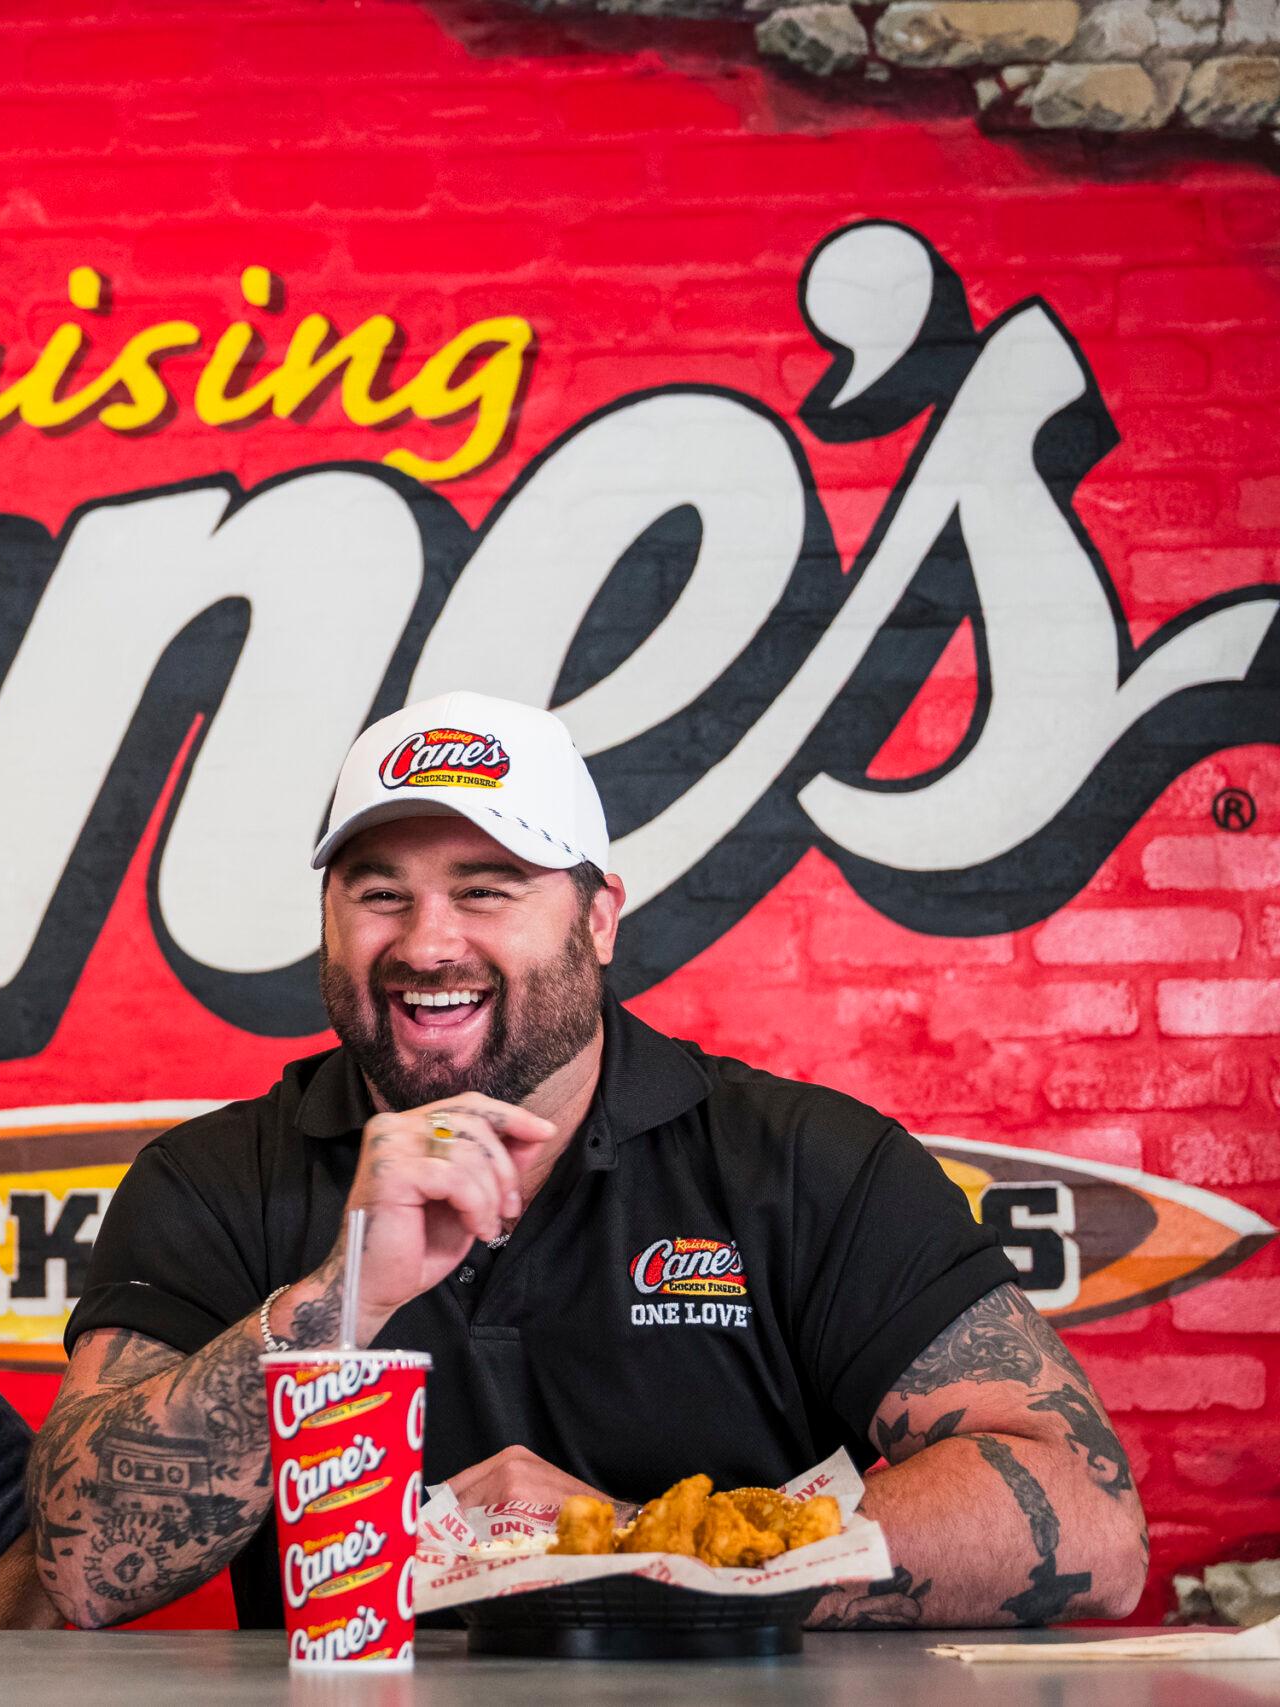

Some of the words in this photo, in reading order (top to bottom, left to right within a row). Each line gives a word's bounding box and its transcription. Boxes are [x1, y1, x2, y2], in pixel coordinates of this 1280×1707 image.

[427, 730, 473, 745] Raising
[382, 733, 509, 787] Cane's
[675, 1238, 718, 1252] Raising
[634, 1239, 744, 1294] Cane's
[631, 1303, 680, 1326] ONE
[279, 1434, 387, 1524] Cane's
[490, 1520, 536, 1538] ONE
[285, 1519, 387, 1609] Cane's
